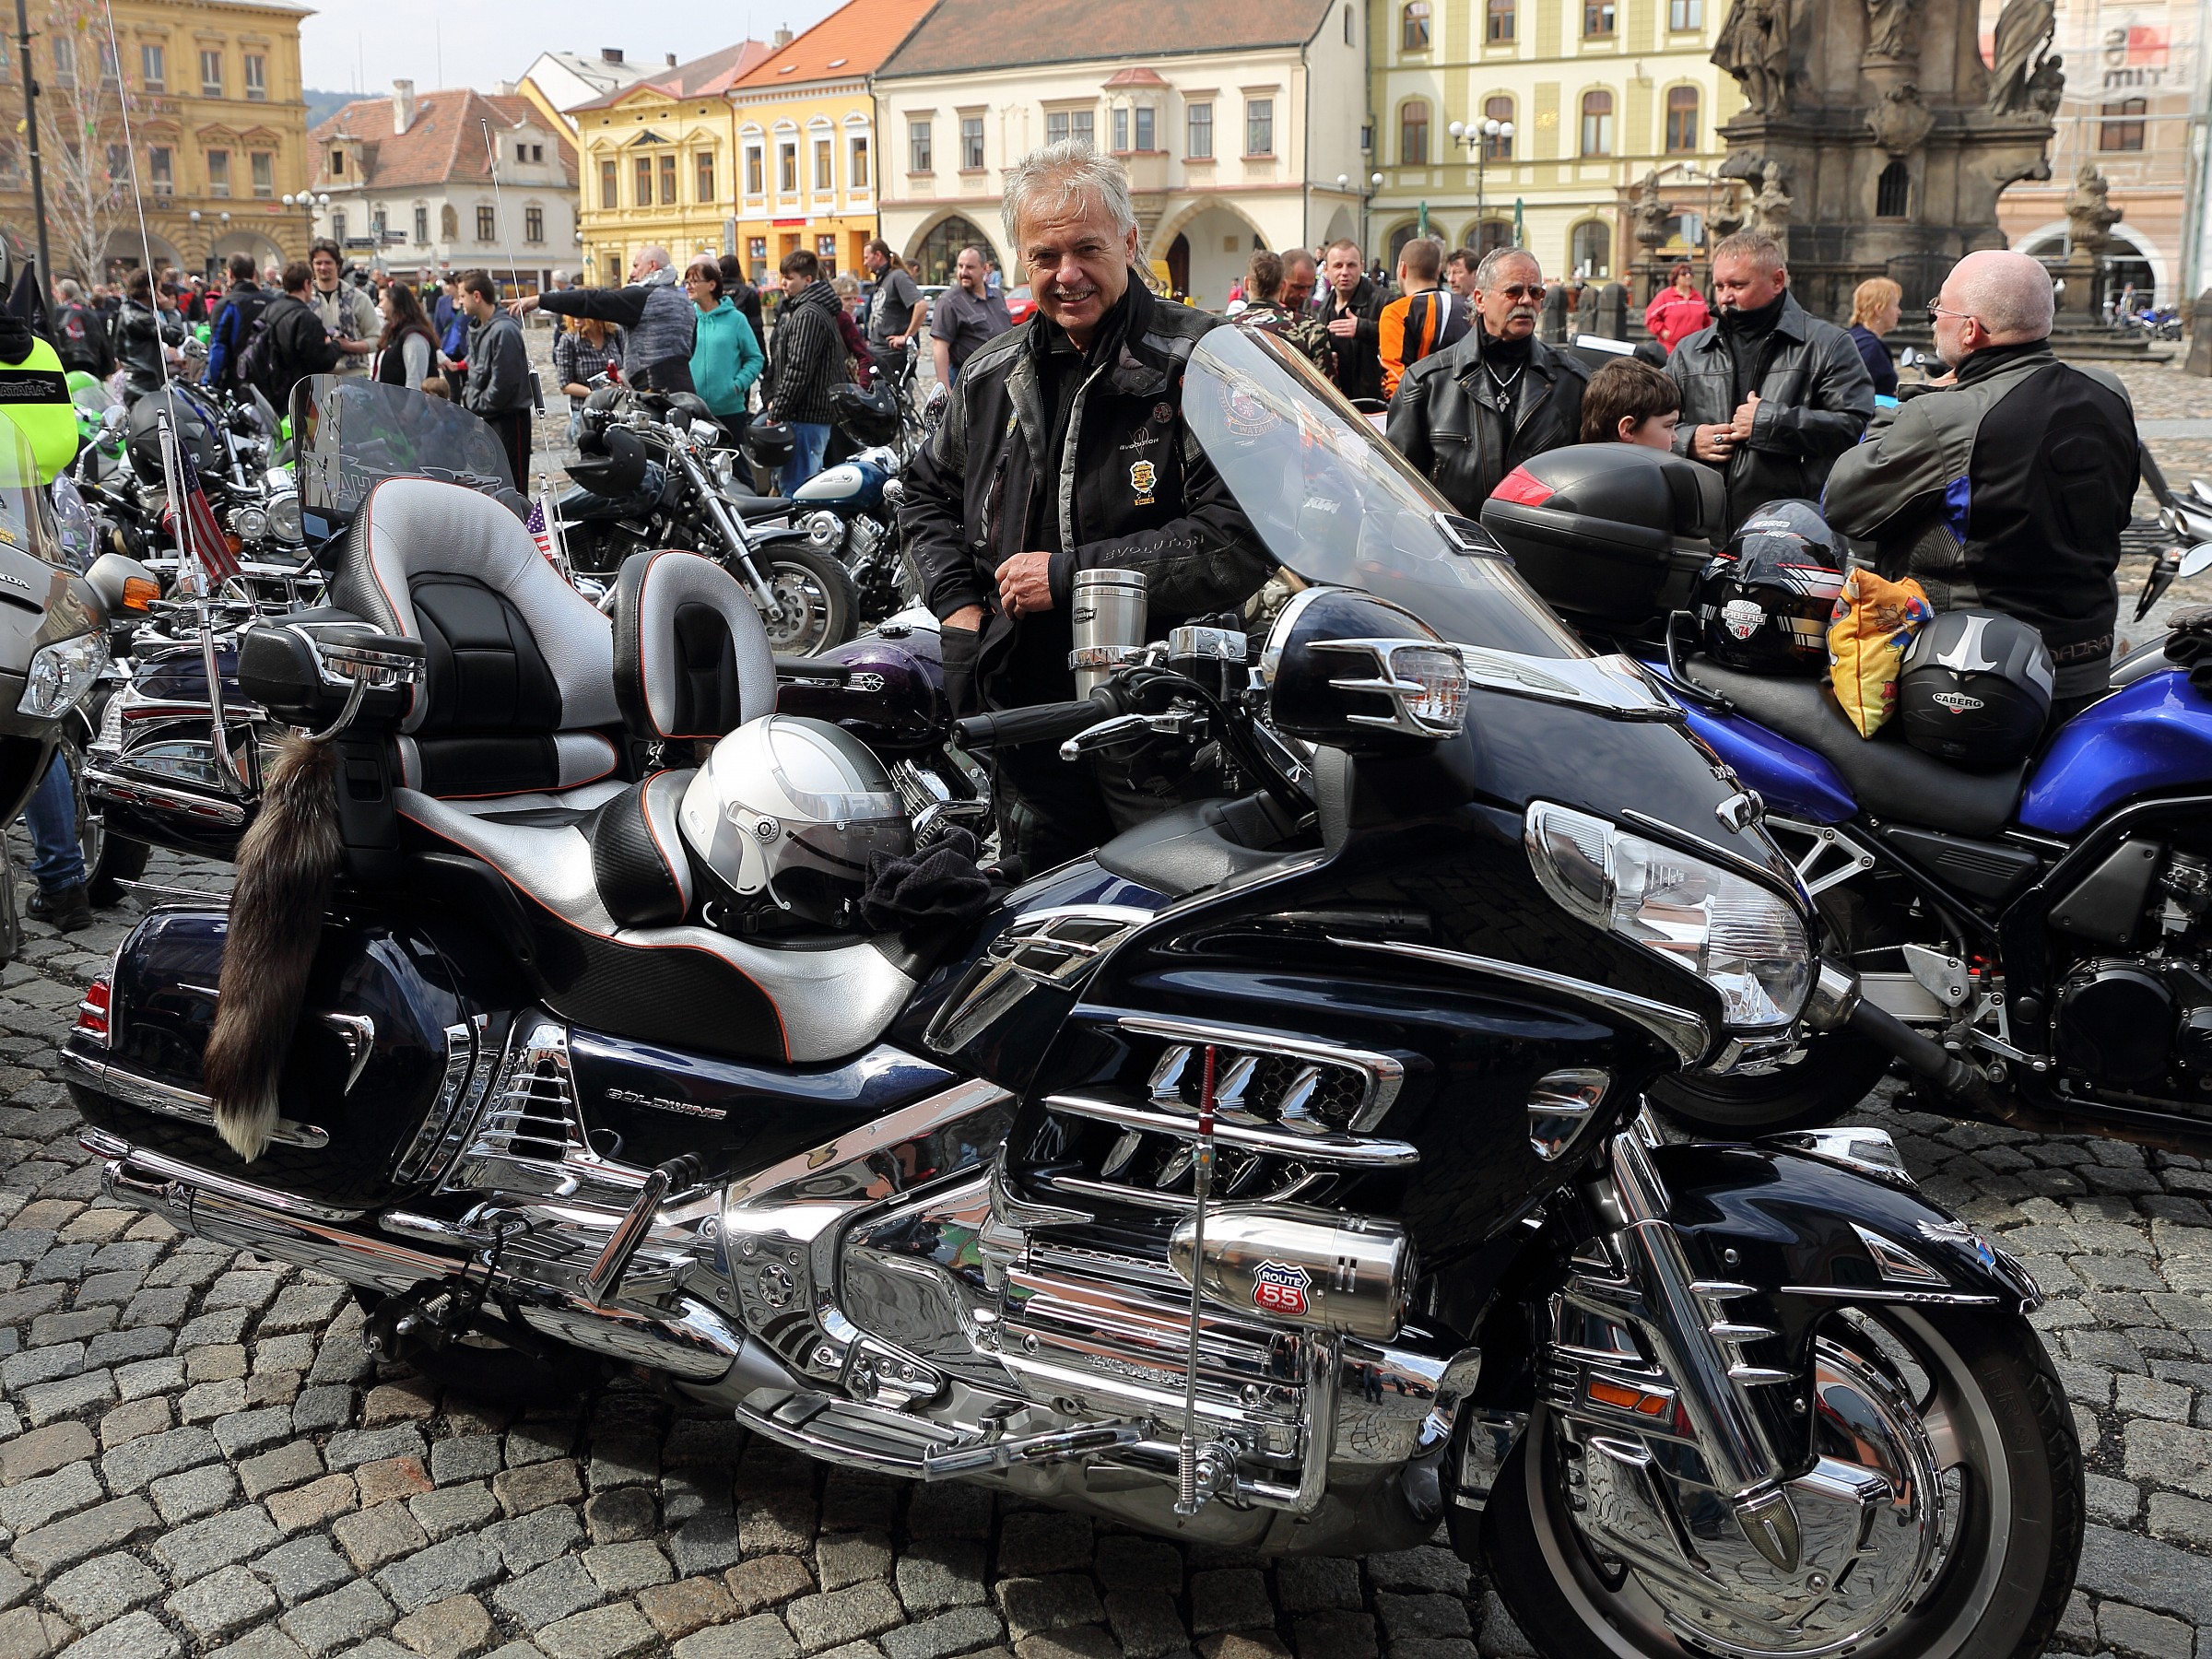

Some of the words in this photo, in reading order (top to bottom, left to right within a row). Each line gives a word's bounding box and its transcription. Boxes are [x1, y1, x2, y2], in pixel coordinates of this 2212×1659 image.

[0, 385, 45, 396] ATAHA
[1723, 609, 1764, 623] CABERG
[1733, 625, 1749, 638] 1974
[1935, 694, 1982, 708] CABERG
[1262, 1271, 1302, 1287] ROUTE
[1263, 1285, 1299, 1307] 55
[1277, 1304, 1302, 1312] MOTO
